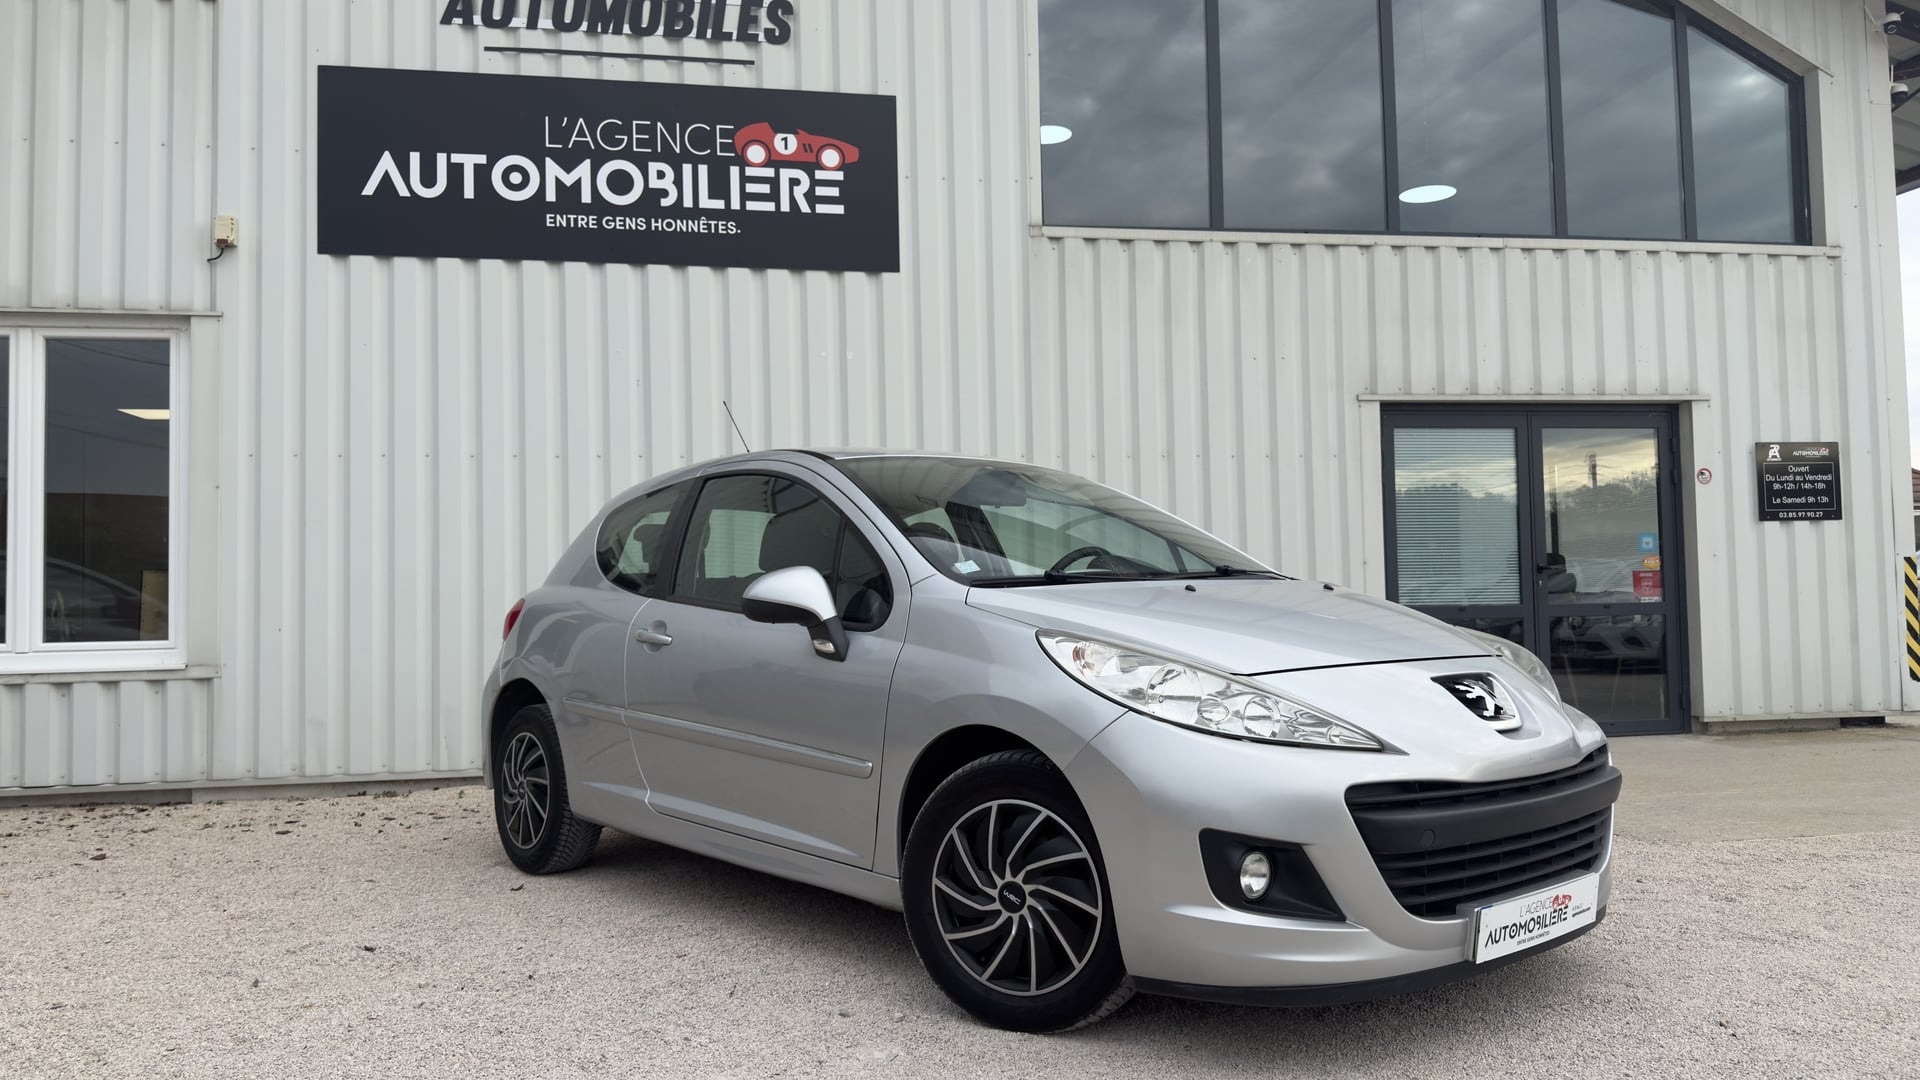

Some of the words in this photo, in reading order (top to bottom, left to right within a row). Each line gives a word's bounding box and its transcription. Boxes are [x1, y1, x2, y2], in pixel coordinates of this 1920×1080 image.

[545, 116, 735, 157] L'AGENCE
[780, 136, 789, 151] 1
[361, 150, 845, 214] AUTOMOBILIERE
[546, 213, 598, 229] ENTRE
[602, 216, 647, 231] GENS
[651, 216, 741, 234] HONNÊTES.
[1782, 496, 1806, 504] Samedi
[1519, 896, 1553, 917] L'AGENCE
[1484, 904, 1568, 948] AUTOMOBILIERE
